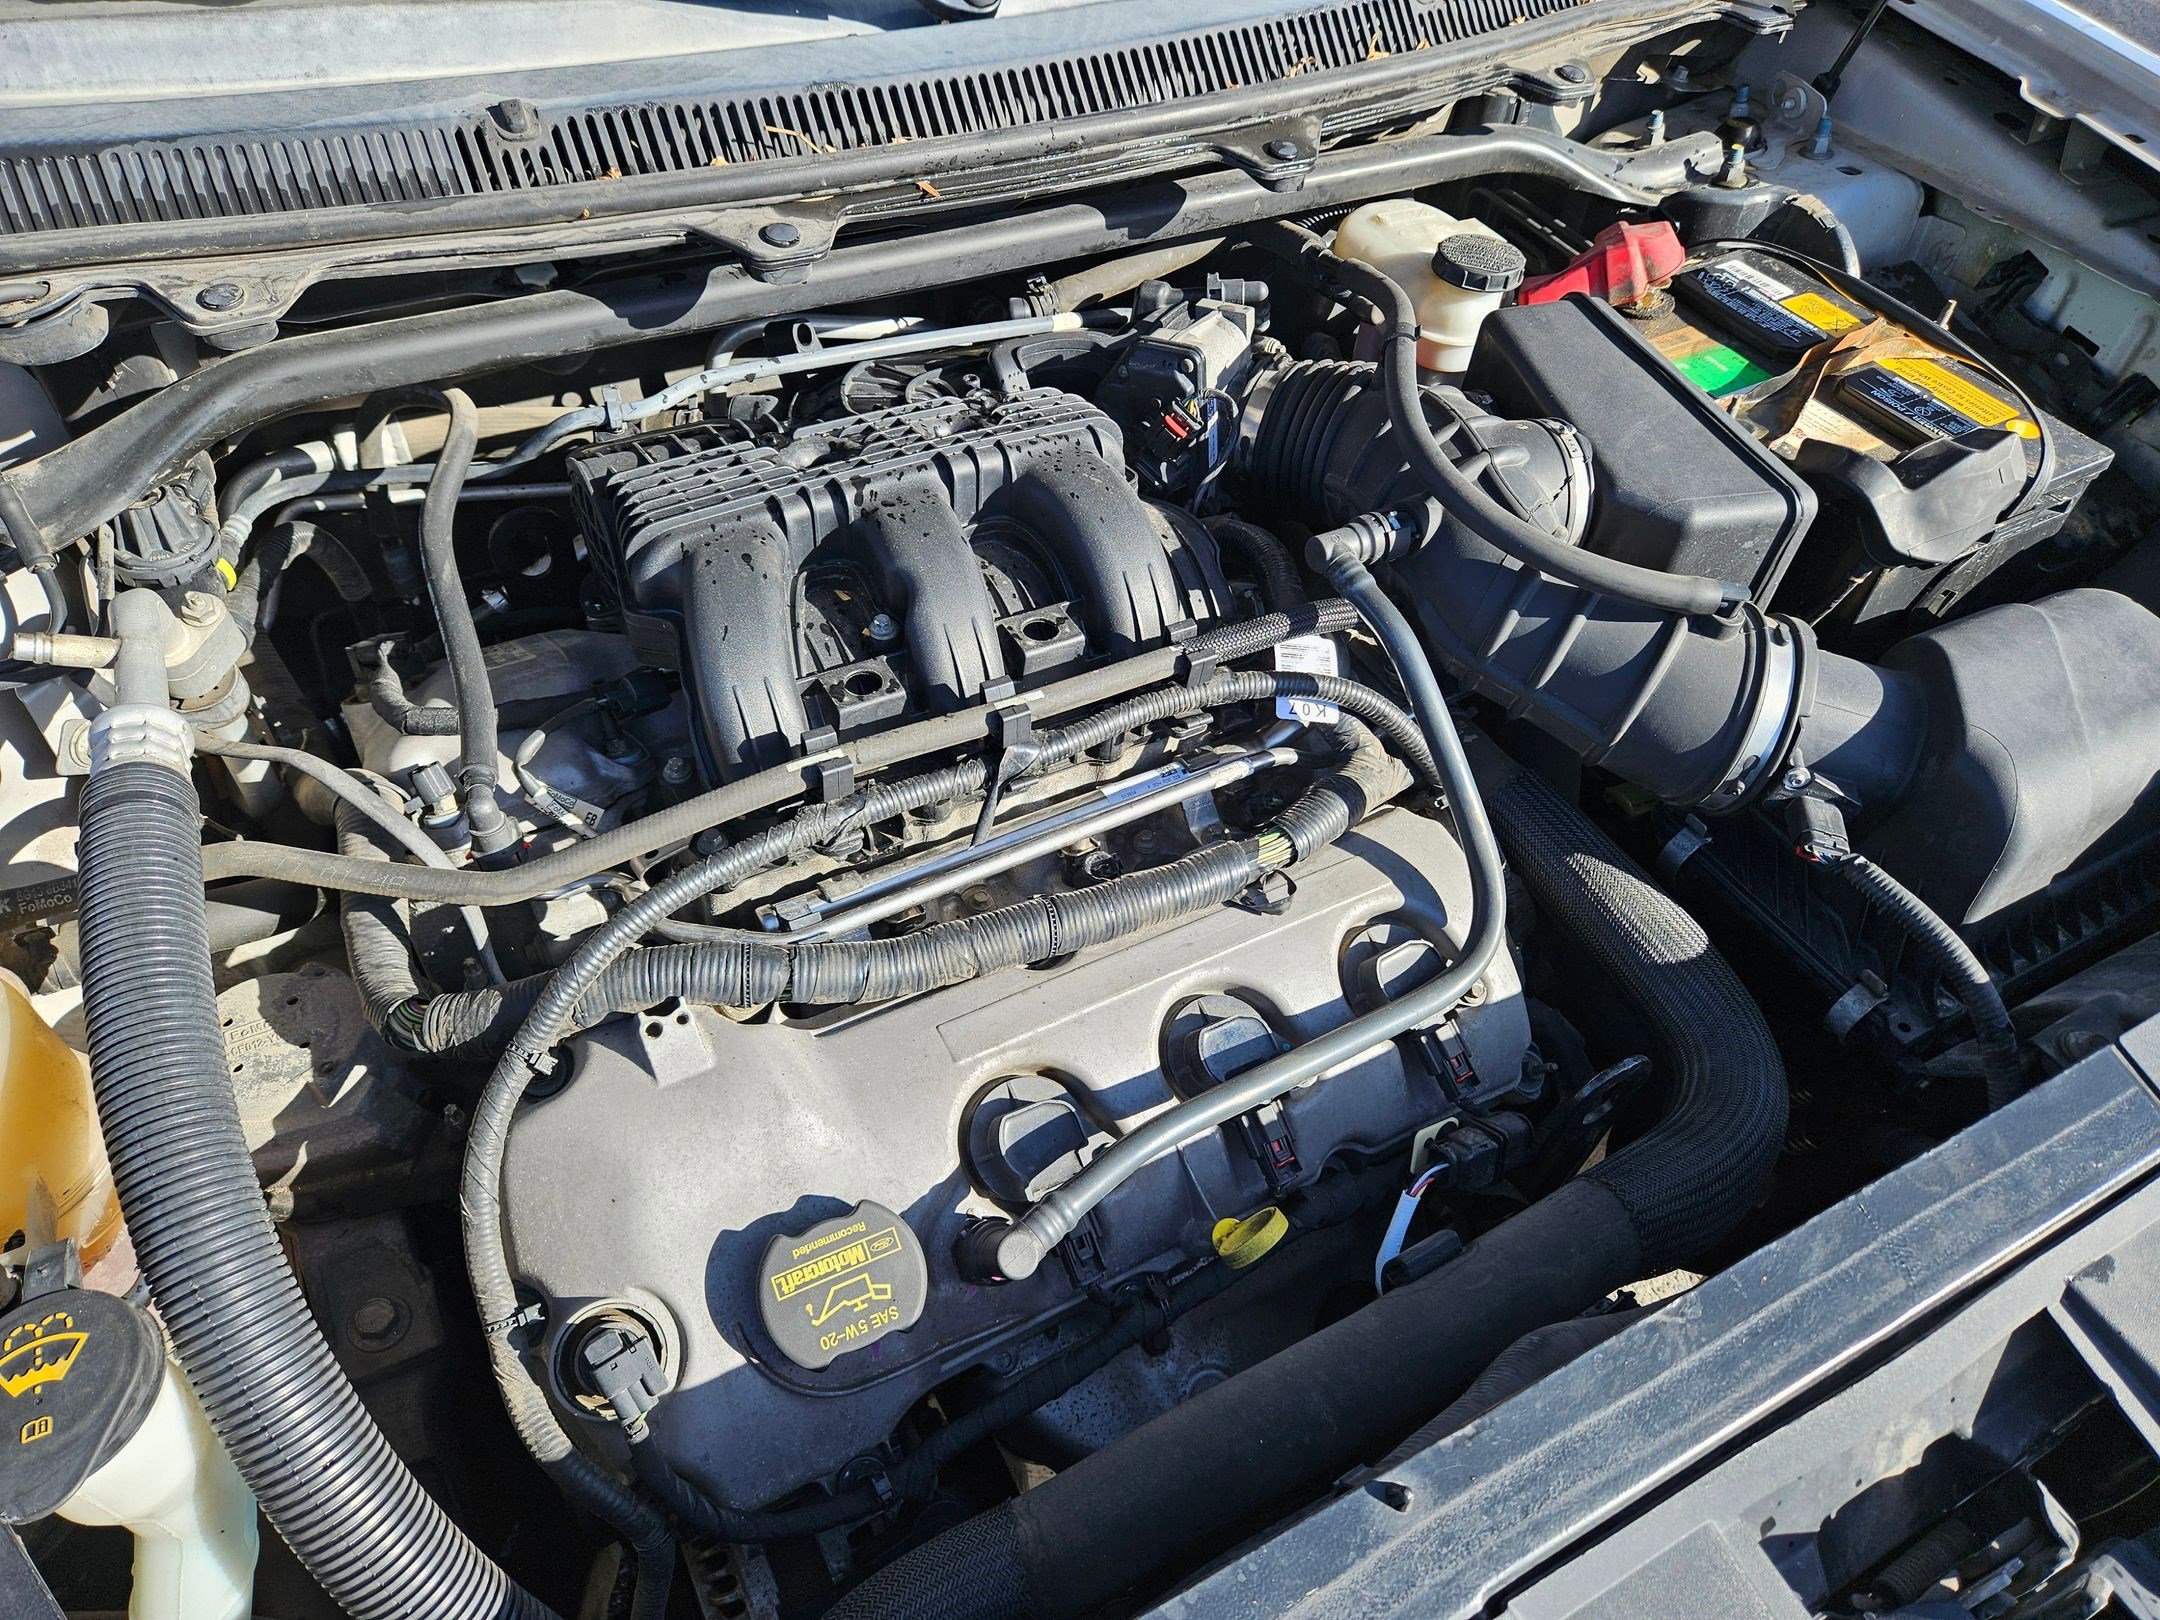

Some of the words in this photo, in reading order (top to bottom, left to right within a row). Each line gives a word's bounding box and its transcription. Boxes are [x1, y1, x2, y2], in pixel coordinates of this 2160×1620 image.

[1914, 377, 1930, 386] and
[1870, 390, 1907, 412] POISON
[1930, 386, 1963, 406] warranty
[1964, 406, 1991, 422] Return
[585, 811, 598, 826] EB
[18, 894, 73, 914] FoMoCo
[792, 1221, 867, 1260] Recommended
[871, 1305, 900, 1330] SAE
[820, 1319, 869, 1351] 5W-20
